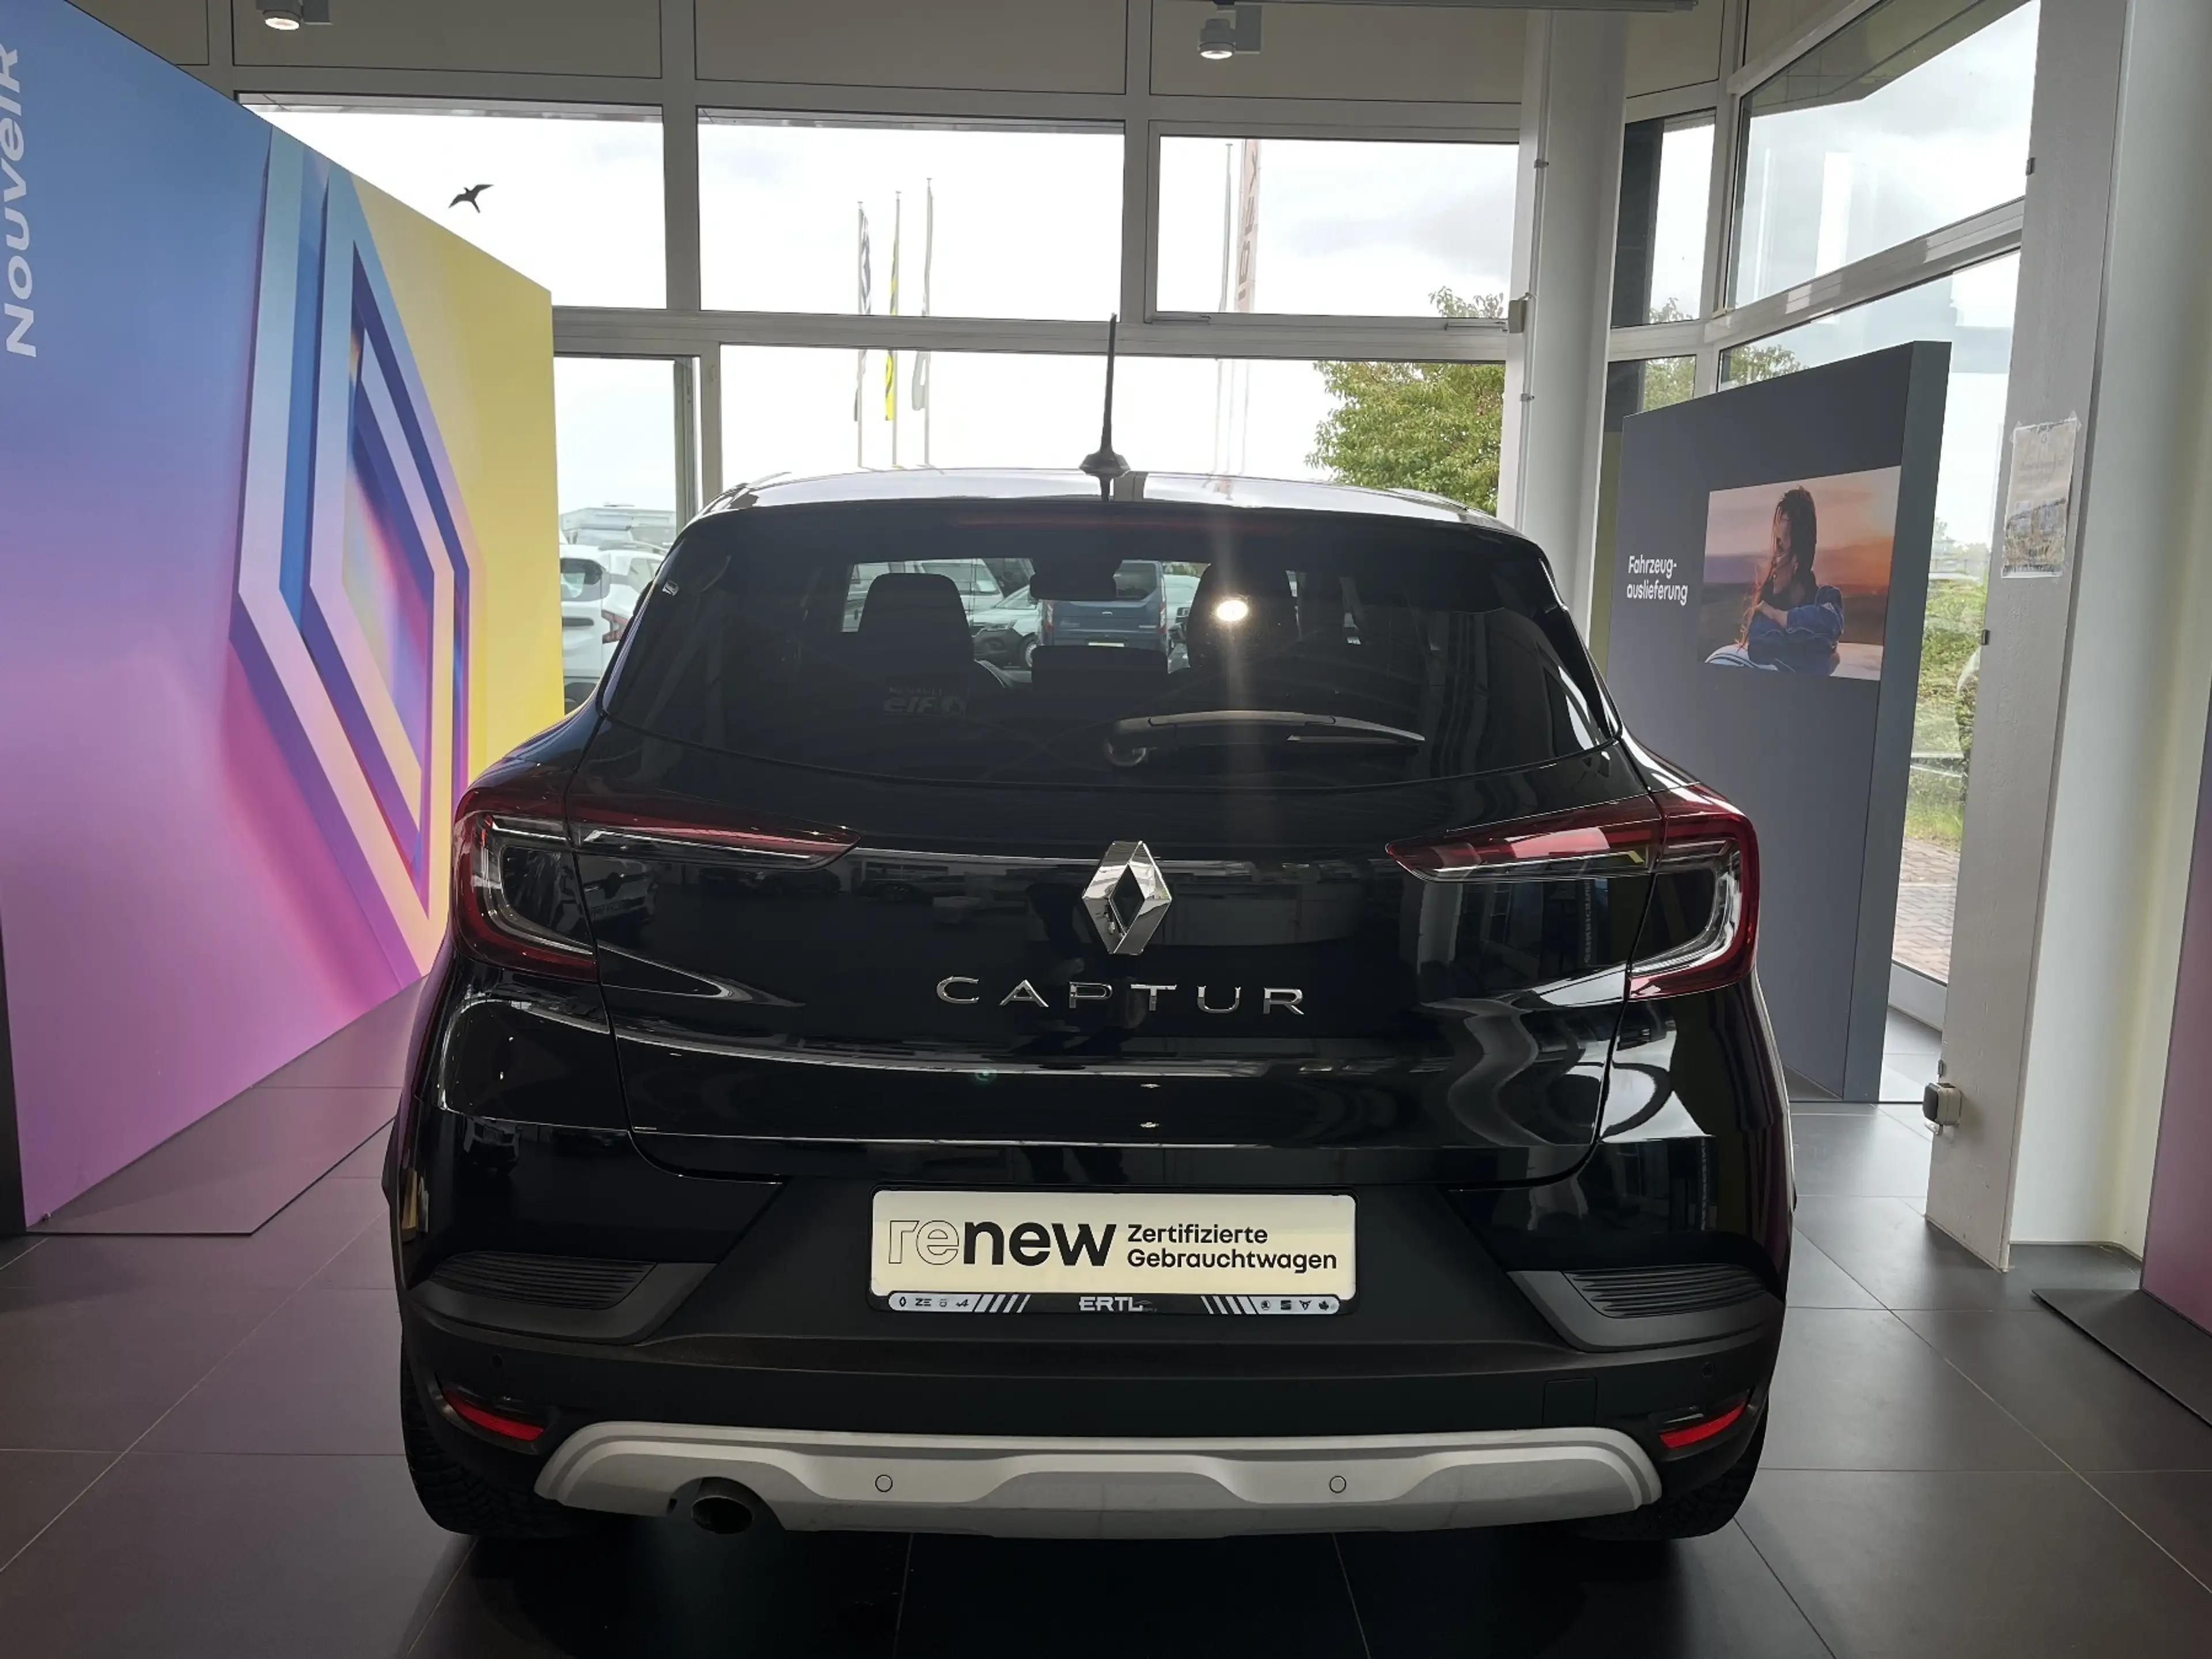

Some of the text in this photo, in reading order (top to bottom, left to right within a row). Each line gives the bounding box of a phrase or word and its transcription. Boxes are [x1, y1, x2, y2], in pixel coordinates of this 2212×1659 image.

[1628, 554, 1677, 579] Fahrzeug-
[1627, 579, 1688, 606] auslieferung
[936, 976, 1305, 1015] CAPTUR
[888, 1220, 1117, 1267] renew
[1127, 1224, 1268, 1244] Zertifizierte
[1127, 1248, 1337, 1274] Gebrauchtwagen
[1079, 1296, 1143, 1312] ERTL
